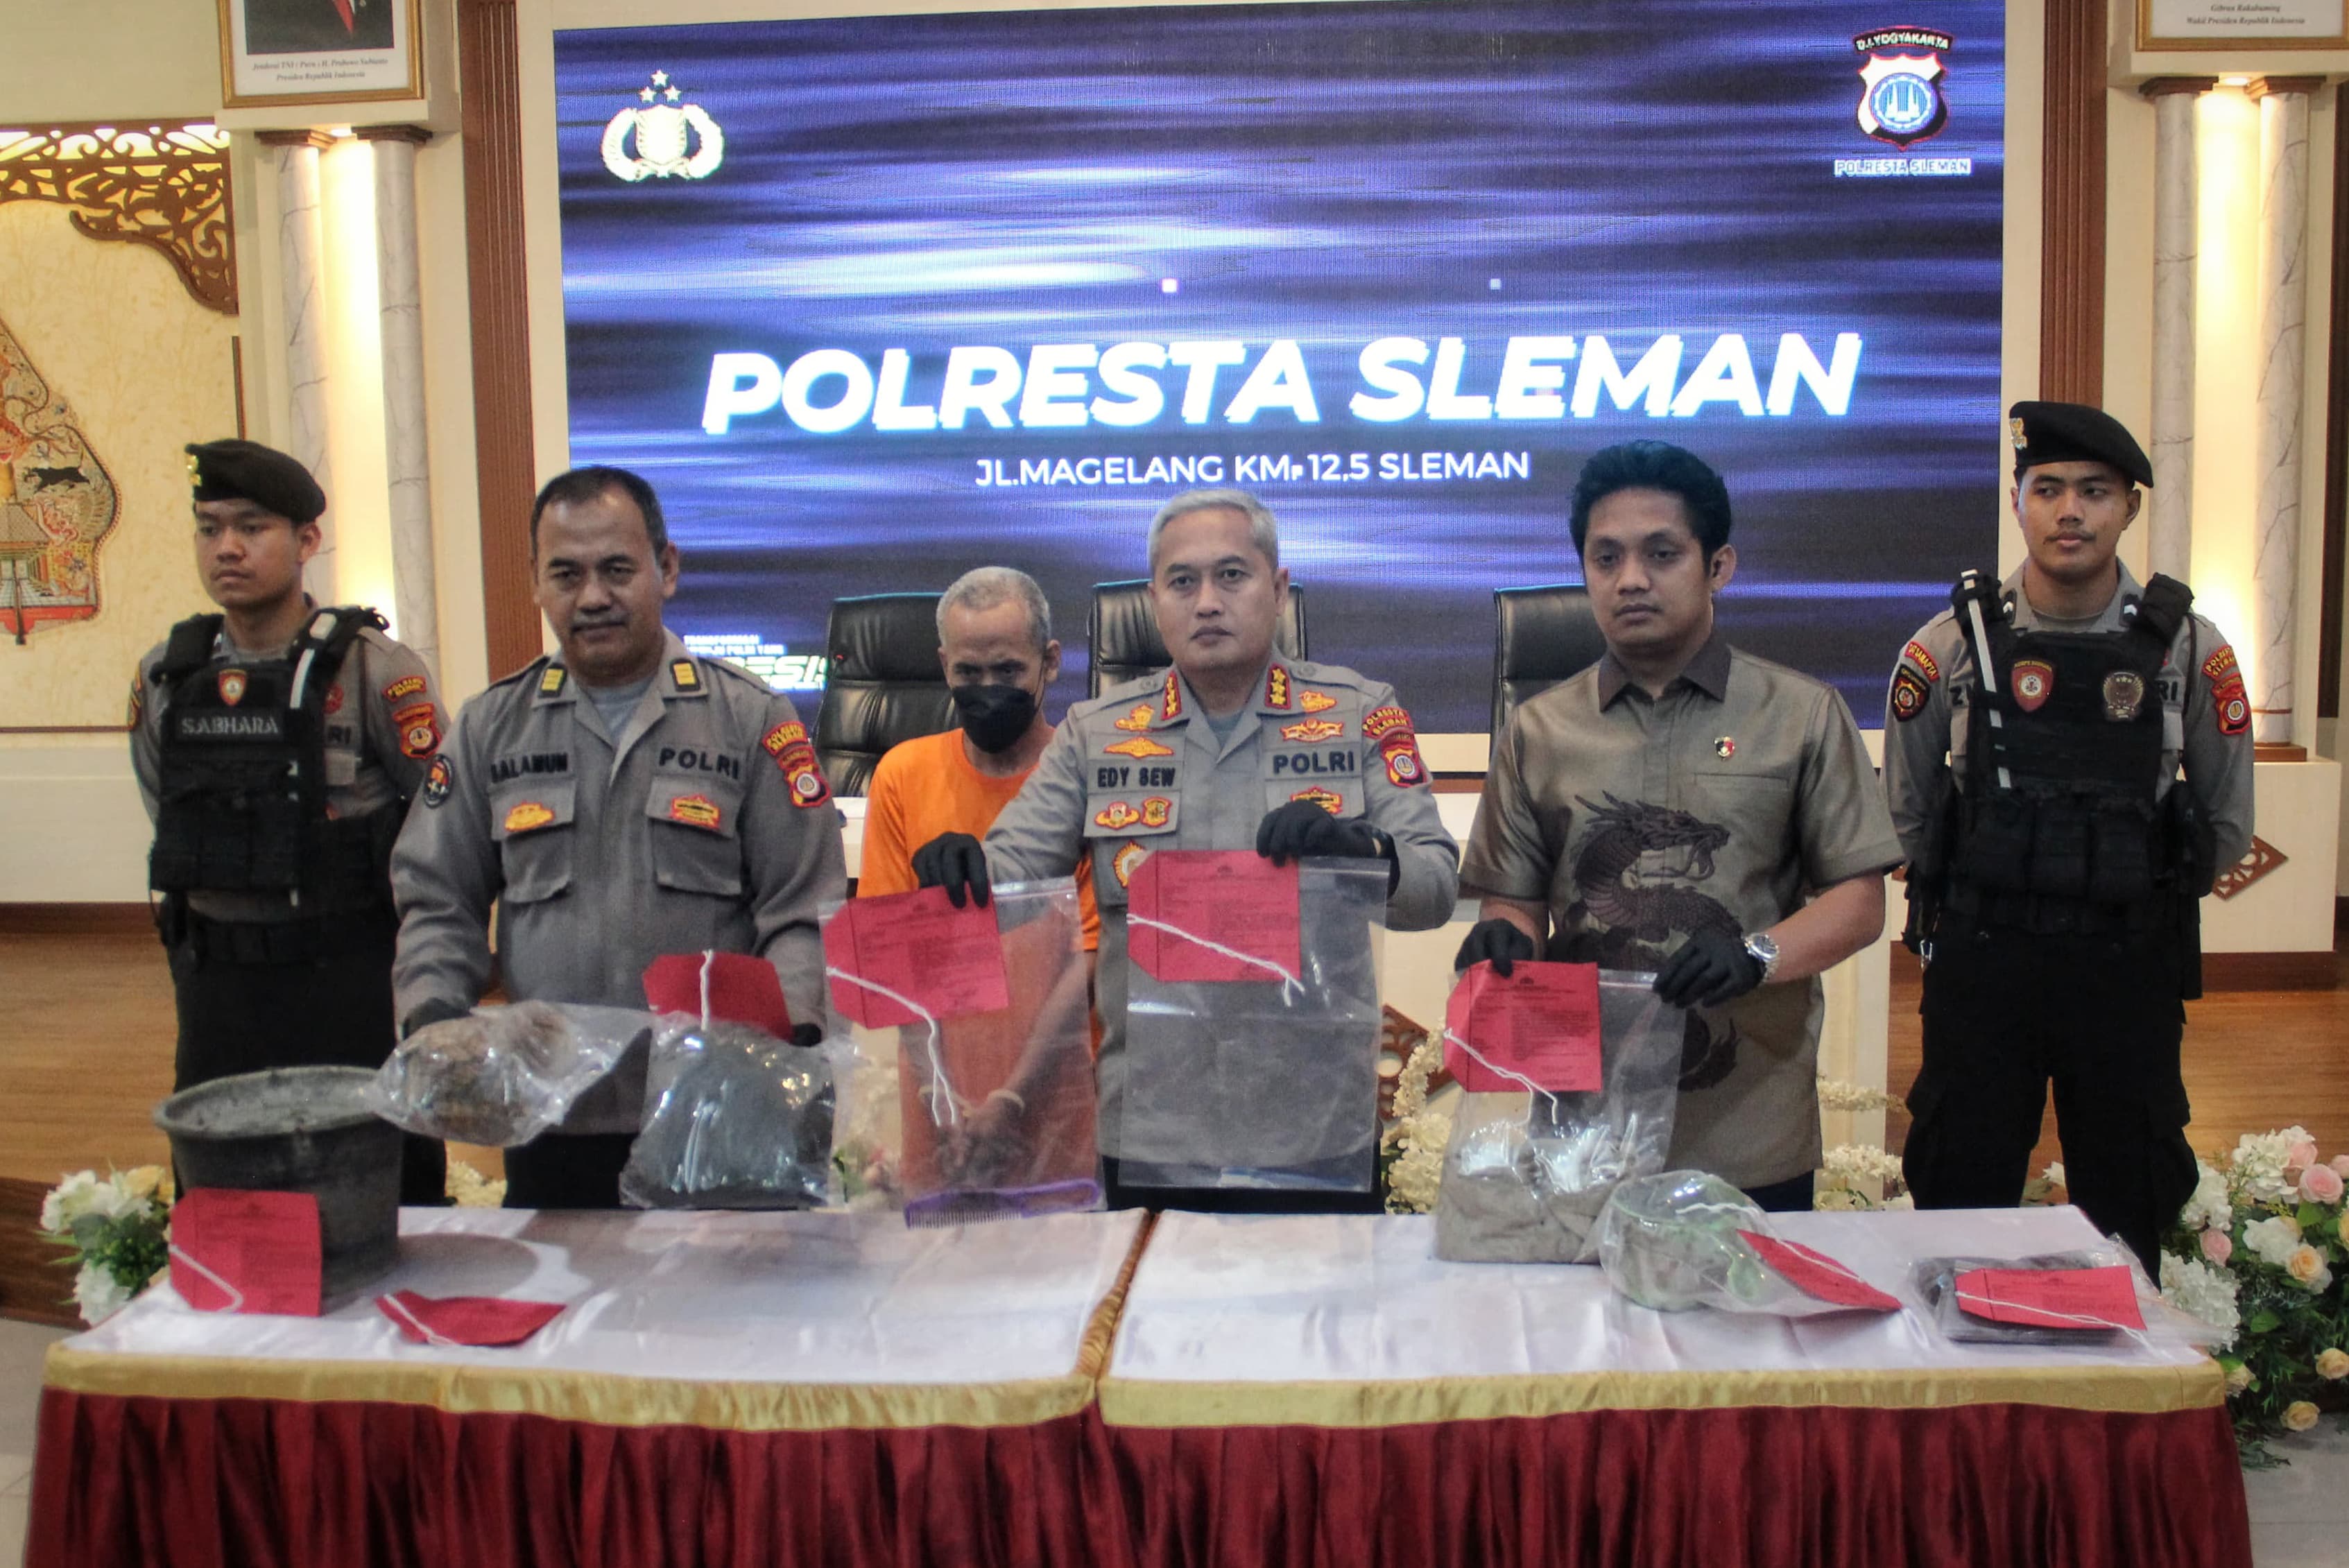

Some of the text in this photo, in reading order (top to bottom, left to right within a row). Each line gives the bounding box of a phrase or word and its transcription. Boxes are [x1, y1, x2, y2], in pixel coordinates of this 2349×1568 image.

[1834, 158, 1972, 178] POLRESTA SLEMAN
[702, 332, 1862, 435] POLRESTA SLEMAN
[975, 455, 1223, 486] JL.MAGELANG
[1379, 451, 1529, 479] SLEMAN
[182, 716, 279, 734] SABHARA
[1362, 709, 1406, 730] POLRESTA
[659, 748, 739, 779] POLRI
[1273, 750, 1354, 775] POLRI
[1097, 767, 1130, 788] EDY
